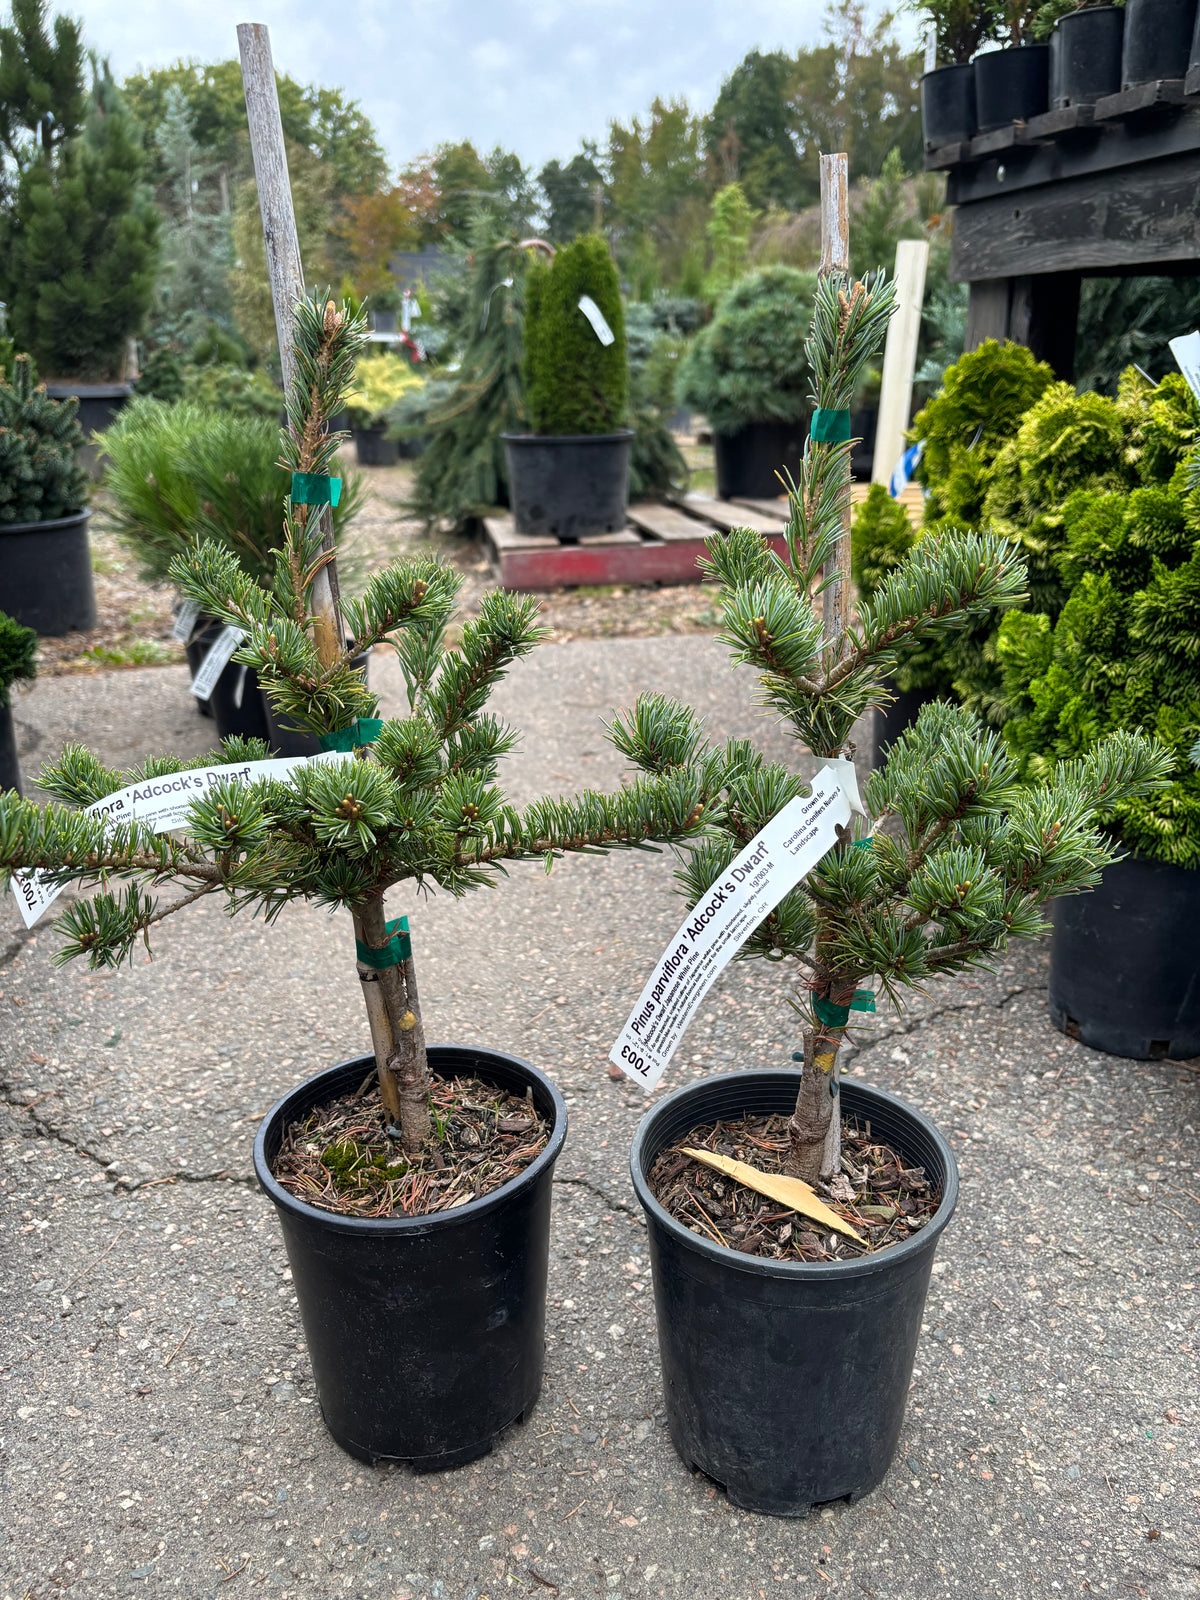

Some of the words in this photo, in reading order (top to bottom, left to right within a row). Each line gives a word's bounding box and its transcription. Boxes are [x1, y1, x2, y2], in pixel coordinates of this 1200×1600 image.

[126, 776, 203, 804] 'Adcock's
[801, 797, 819, 815] Grown
[816, 790, 825, 801] for
[782, 825, 807, 849] Carolina
[805, 805, 826, 826] Conifers
[789, 826, 819, 855] Landscape
[630, 1001, 656, 1036] Pinus
[650, 943, 690, 1005] parviflora
[682, 882, 736, 943] 'Adcock's
[730, 840, 769, 883] Dwarf'
[733, 915, 760, 942] Silverton,
[757, 901, 770, 914] OR
[655, 1004, 667, 1022] Dwarf
[664, 981, 681, 1006] Japanese
[677, 964, 691, 981] White
[687, 951, 700, 966] Pine
[620, 1045, 651, 1078] 7003
